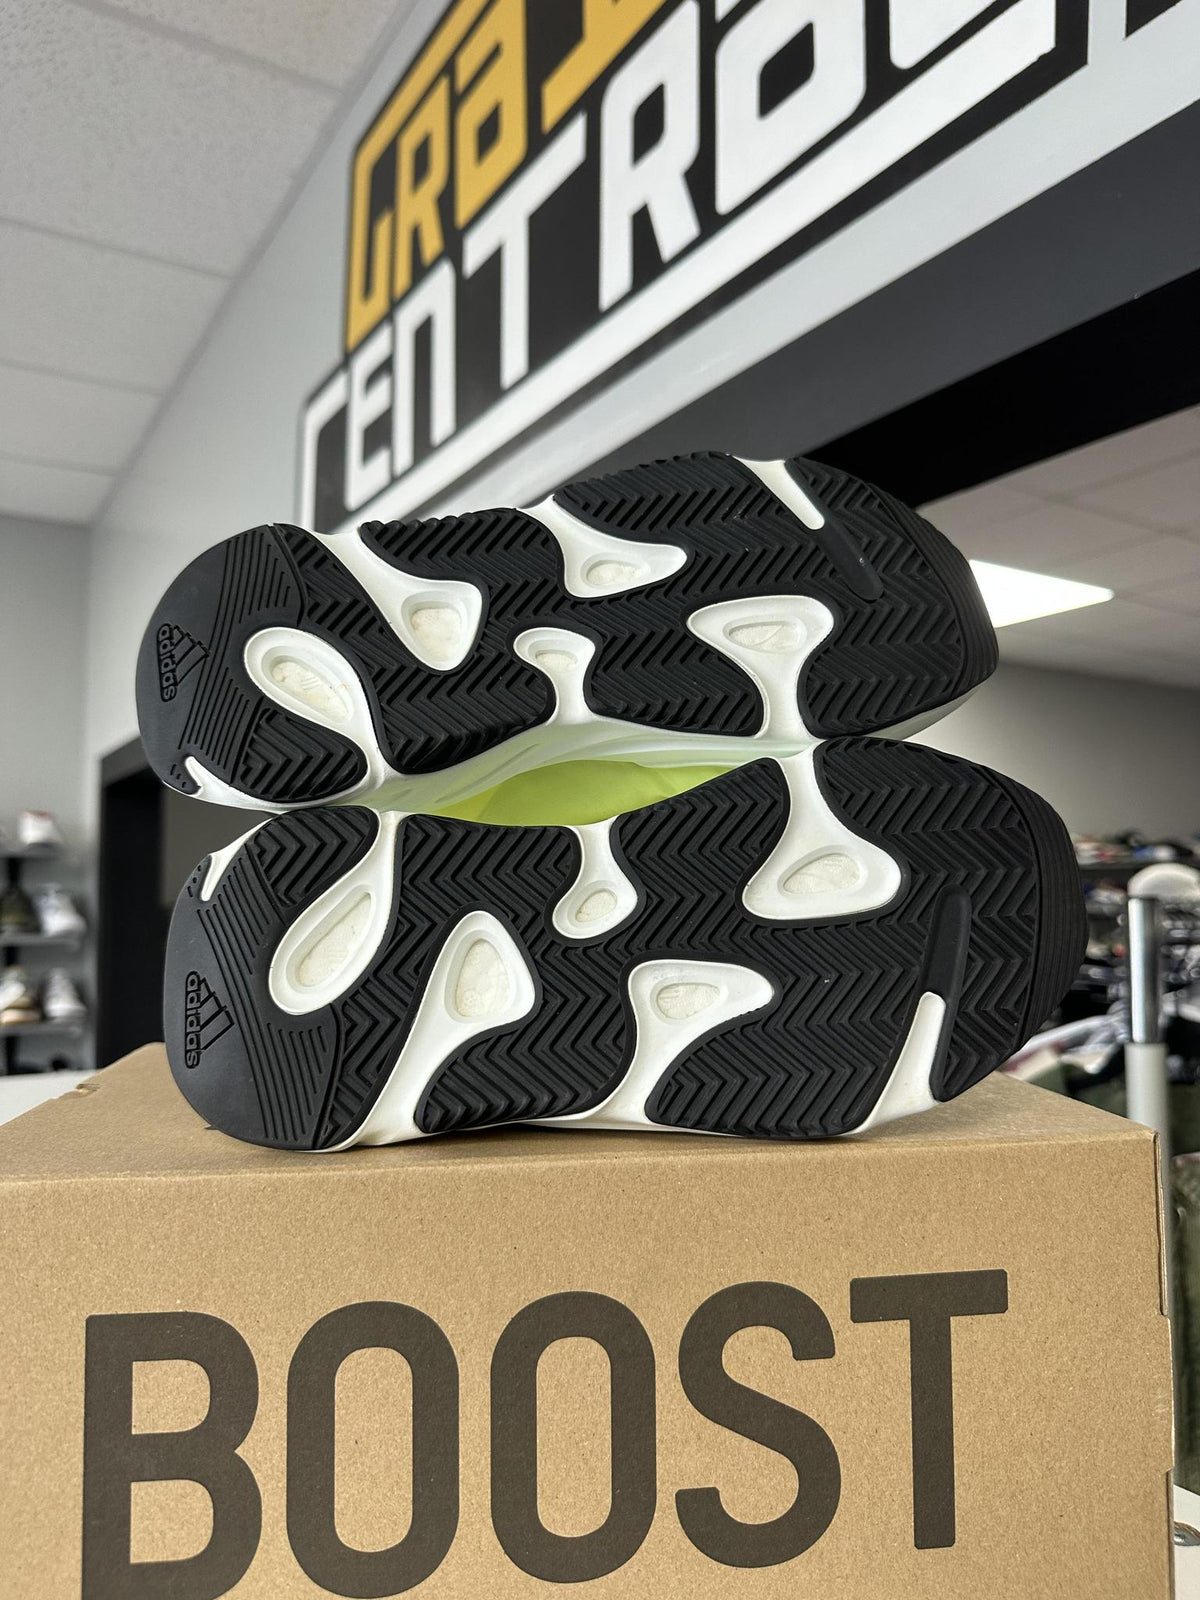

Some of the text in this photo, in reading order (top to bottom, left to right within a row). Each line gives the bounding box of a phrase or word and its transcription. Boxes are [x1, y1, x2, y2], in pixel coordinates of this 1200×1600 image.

[157, 623, 178, 702] adidas
[185, 971, 202, 1068] adidas
[82, 1268, 1009, 1600] BOOST
